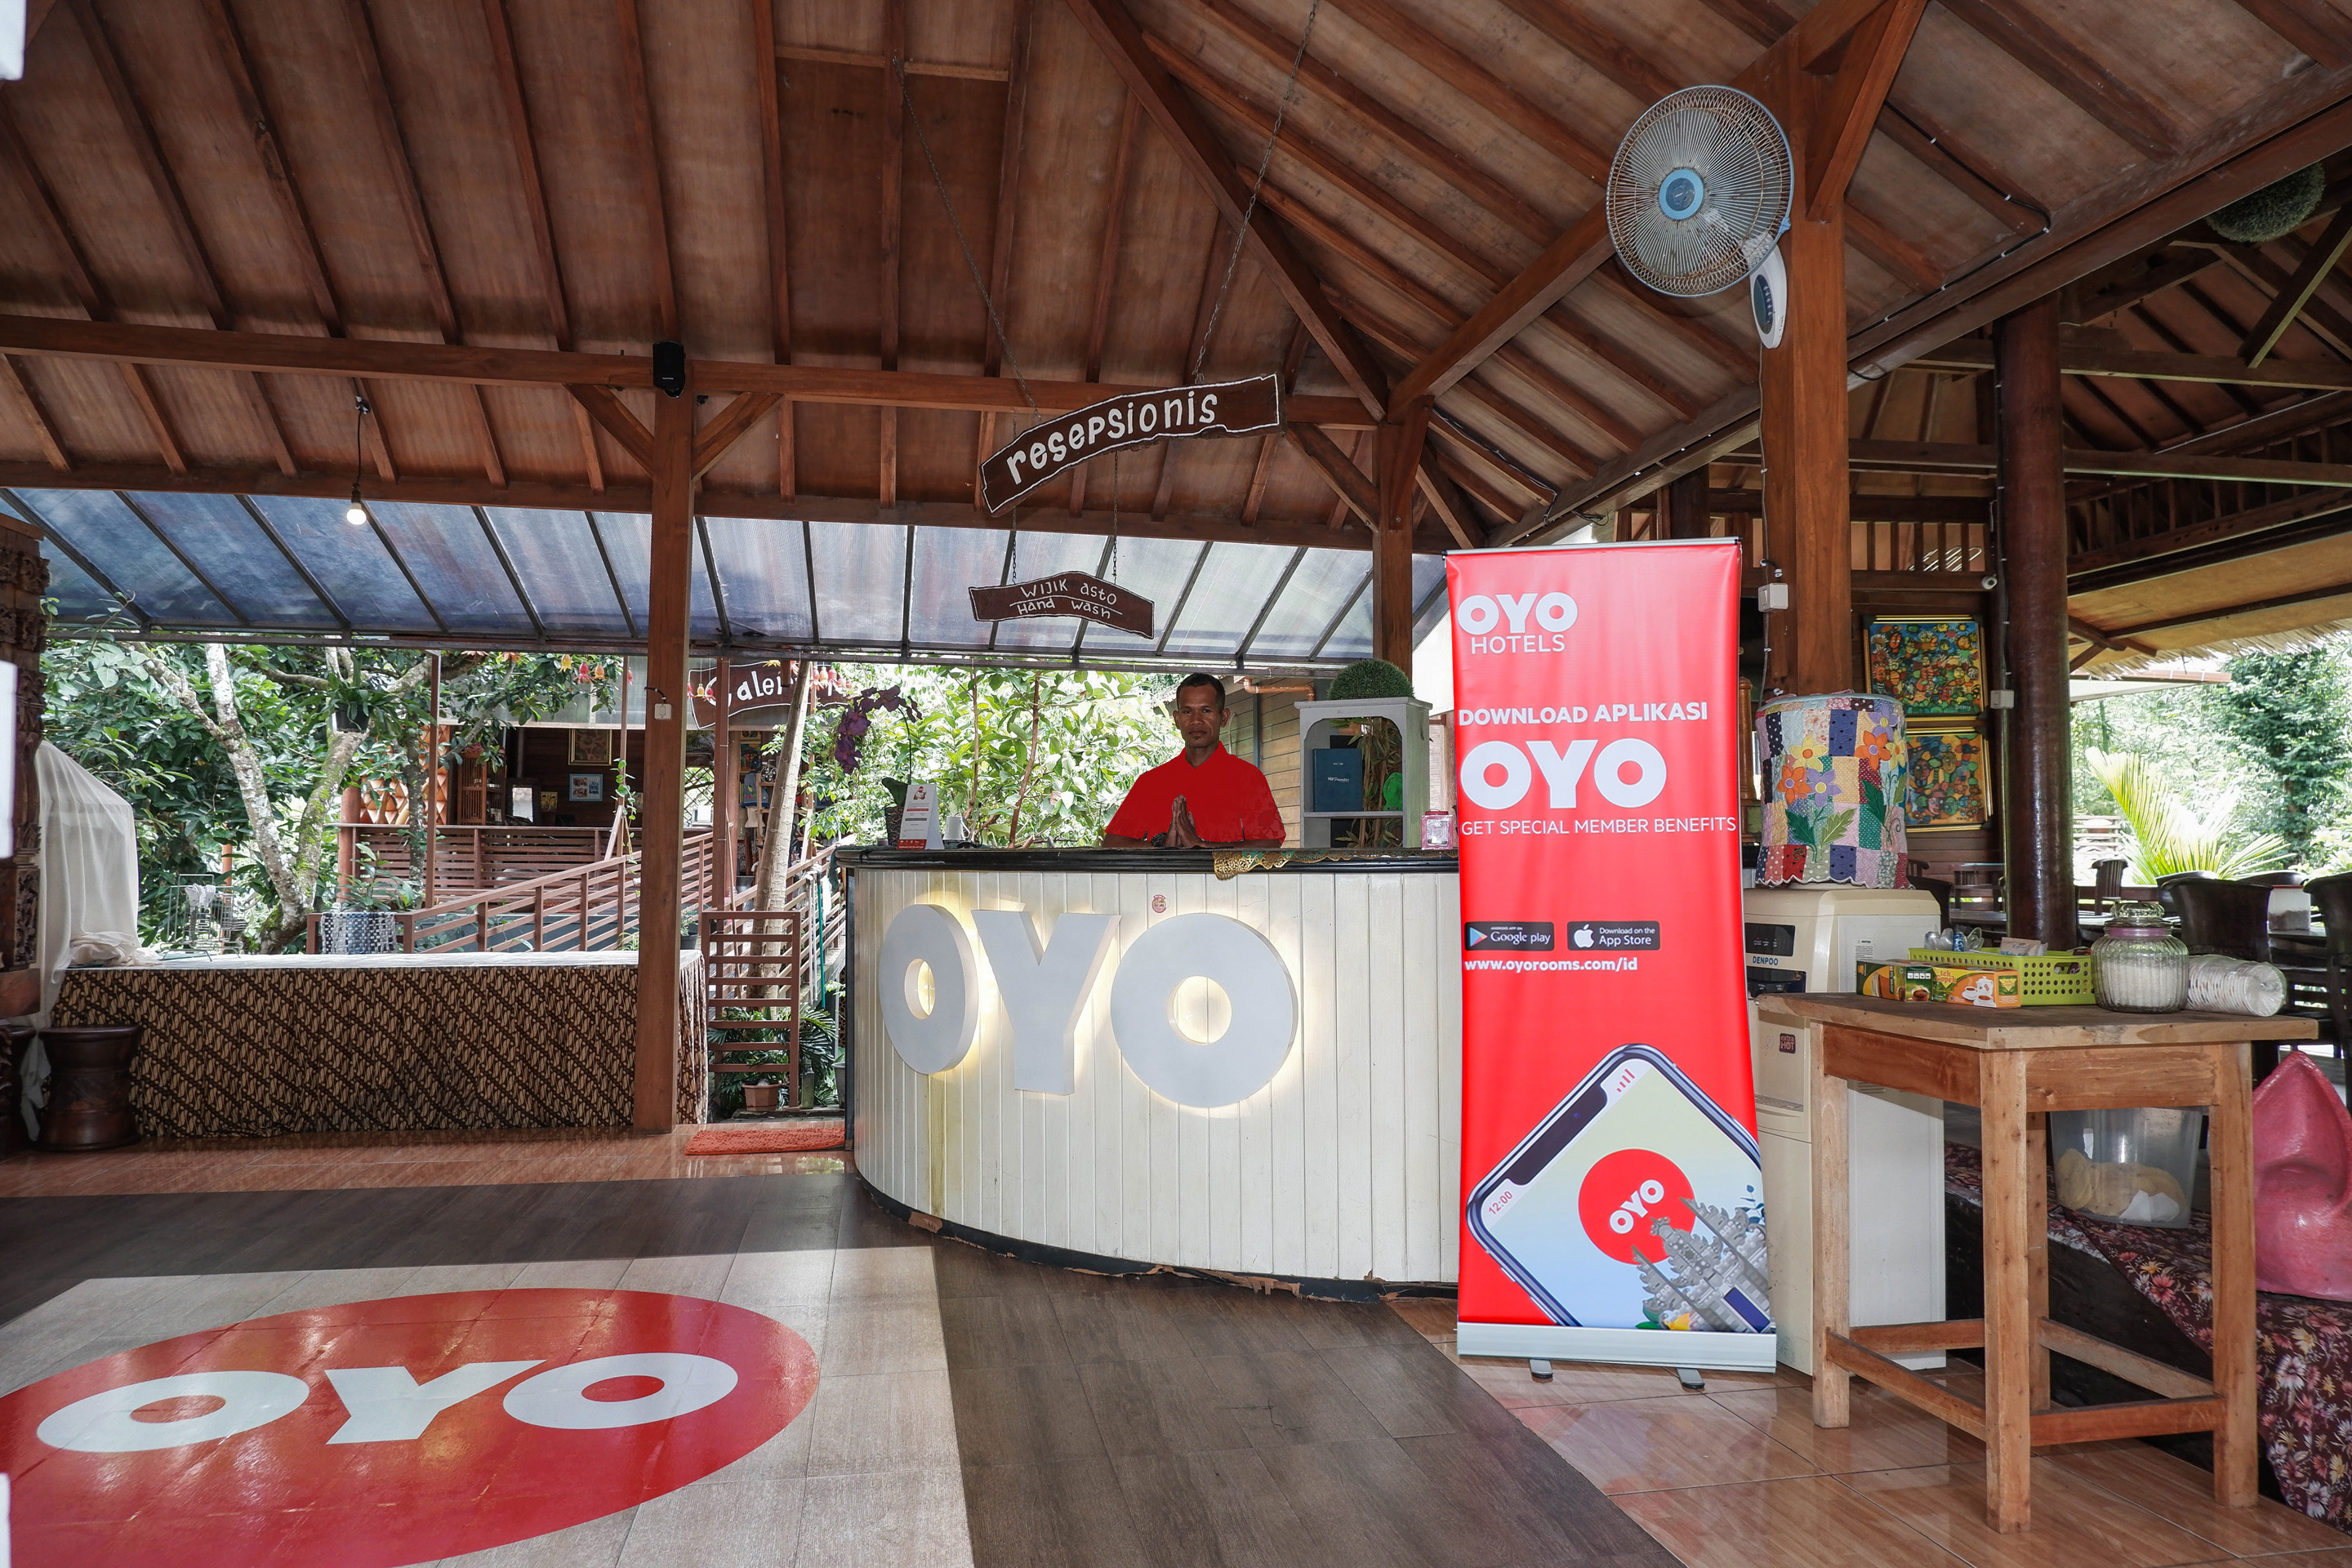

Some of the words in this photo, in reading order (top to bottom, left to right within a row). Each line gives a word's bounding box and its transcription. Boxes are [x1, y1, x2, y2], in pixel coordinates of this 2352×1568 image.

[1006, 390, 1218, 485] resepsionis
[1080, 582, 1117, 605] asto
[1017, 597, 1056, 615] Hand
[1071, 600, 1111, 619] wash
[1457, 591, 1579, 635] OYO
[1471, 634, 1566, 655] HOTELS
[1459, 706, 1588, 726] DOWNLOAD
[1593, 702, 1708, 723] APLIKASI
[1459, 737, 1668, 811] OYO
[1461, 821, 1495, 836] GET
[1500, 820, 1570, 835] SPECIAL
[1575, 818, 1649, 834] MEMBER
[1654, 817, 1737, 833] BENEFITS
[1490, 931, 1527, 945] Google
[1530, 933, 1551, 944] play
[1599, 936, 1621, 947] App
[1624, 934, 1652, 945] Store
[1464, 957, 1638, 973] www.oyorooms.com/id
[1753, 956, 1779, 965] DENPOO
[879, 902, 1298, 1109] OYO
[1780, 1040, 1795, 1051] HOT
[1488, 1191, 1513, 1215] 12:00
[1609, 1179, 1665, 1235] OYO
[36, 1352, 739, 1453] OYO
